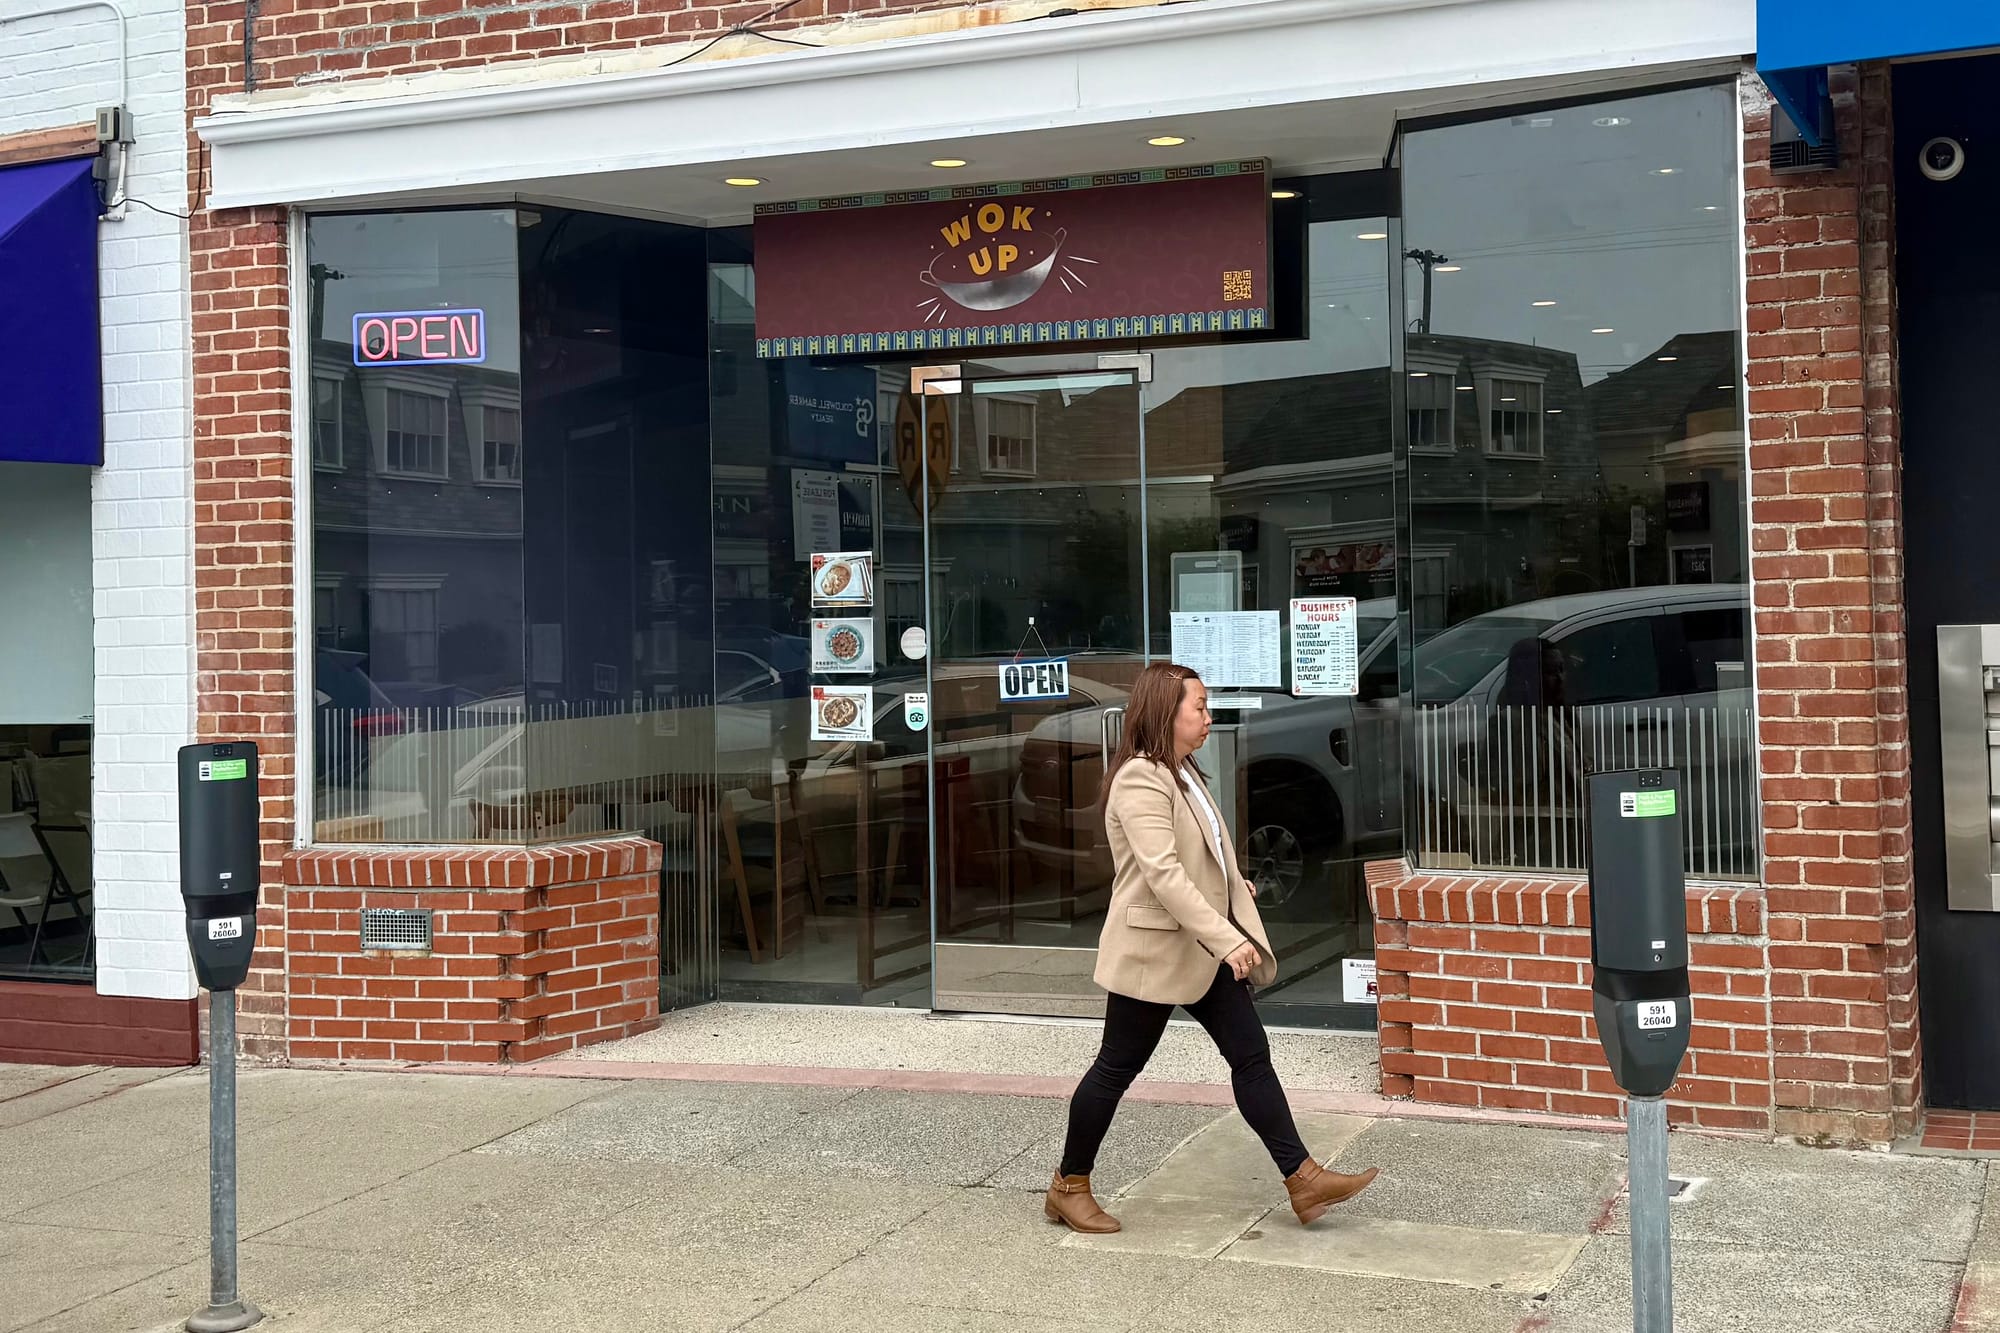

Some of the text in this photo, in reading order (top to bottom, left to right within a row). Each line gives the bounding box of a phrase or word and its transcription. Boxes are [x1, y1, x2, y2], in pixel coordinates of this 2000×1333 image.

[940, 203, 1035, 248] WOK
[968, 245, 1019, 275] UP
[361, 315, 478, 360] OPEN
[1301, 603, 1346, 612] BUSINESS
[1307, 613, 1340, 622] HOURS
[1005, 664, 1064, 696] OPEN
[1649, 1005, 1665, 1015] 591
[1643, 1016, 1671, 1026] 26040
